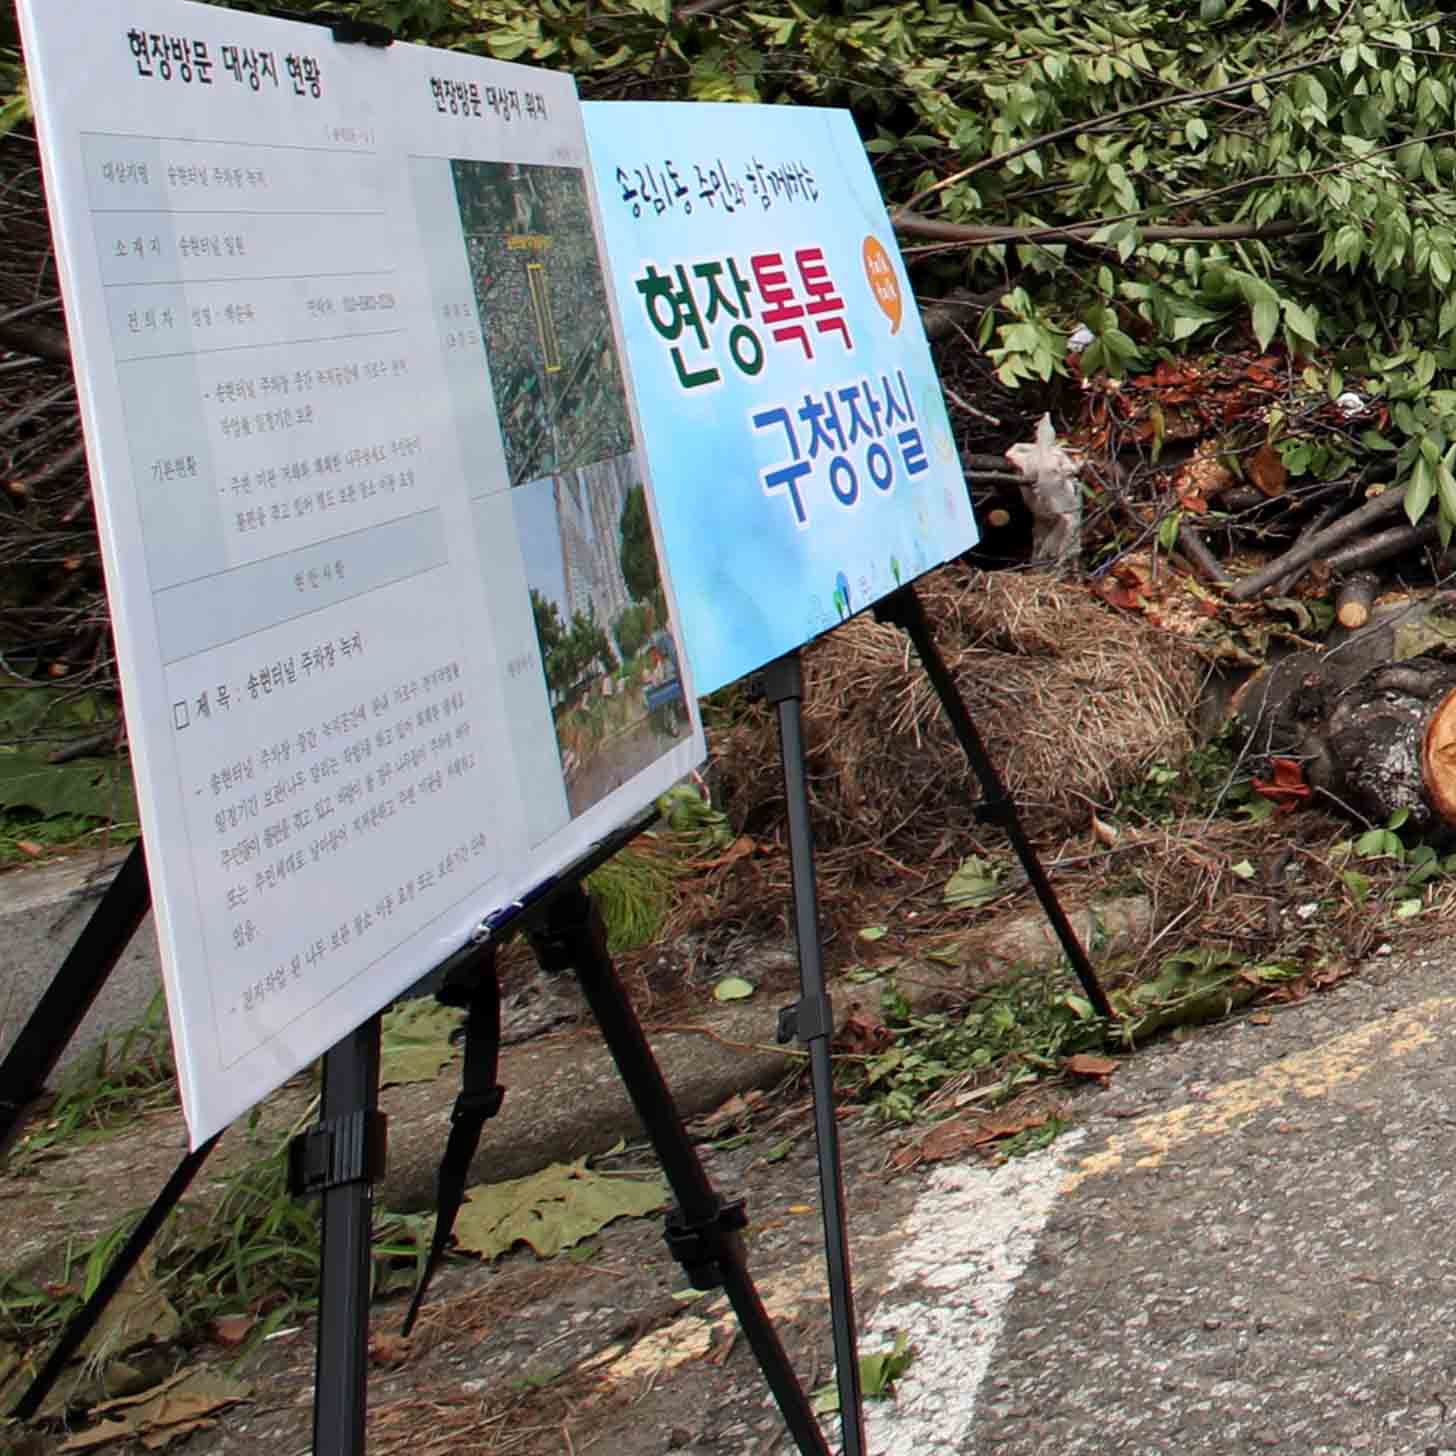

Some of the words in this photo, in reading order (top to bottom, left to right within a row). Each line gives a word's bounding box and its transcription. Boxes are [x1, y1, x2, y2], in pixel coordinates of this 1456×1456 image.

[126, 28, 213, 85] 현장방문
[221, 45, 279, 92] 대상지
[285, 52, 322, 99] 현황
[430, 77, 482, 118] 현장방문
[486, 85, 521, 121] 대상지
[524, 92, 549, 121] 위치
[616, 159, 692, 219] 송림1동
[693, 157, 746, 213] 주민과
[746, 155, 819, 212] 함께하는
[635, 246, 855, 390] 현장톡톡
[752, 370, 929, 523] 구청장실
[247, 656, 297, 699] 송현터널
[302, 642, 335, 676] 주차장
[339, 631, 363, 660] 녹지
[209, 756, 253, 796] 송현터널
